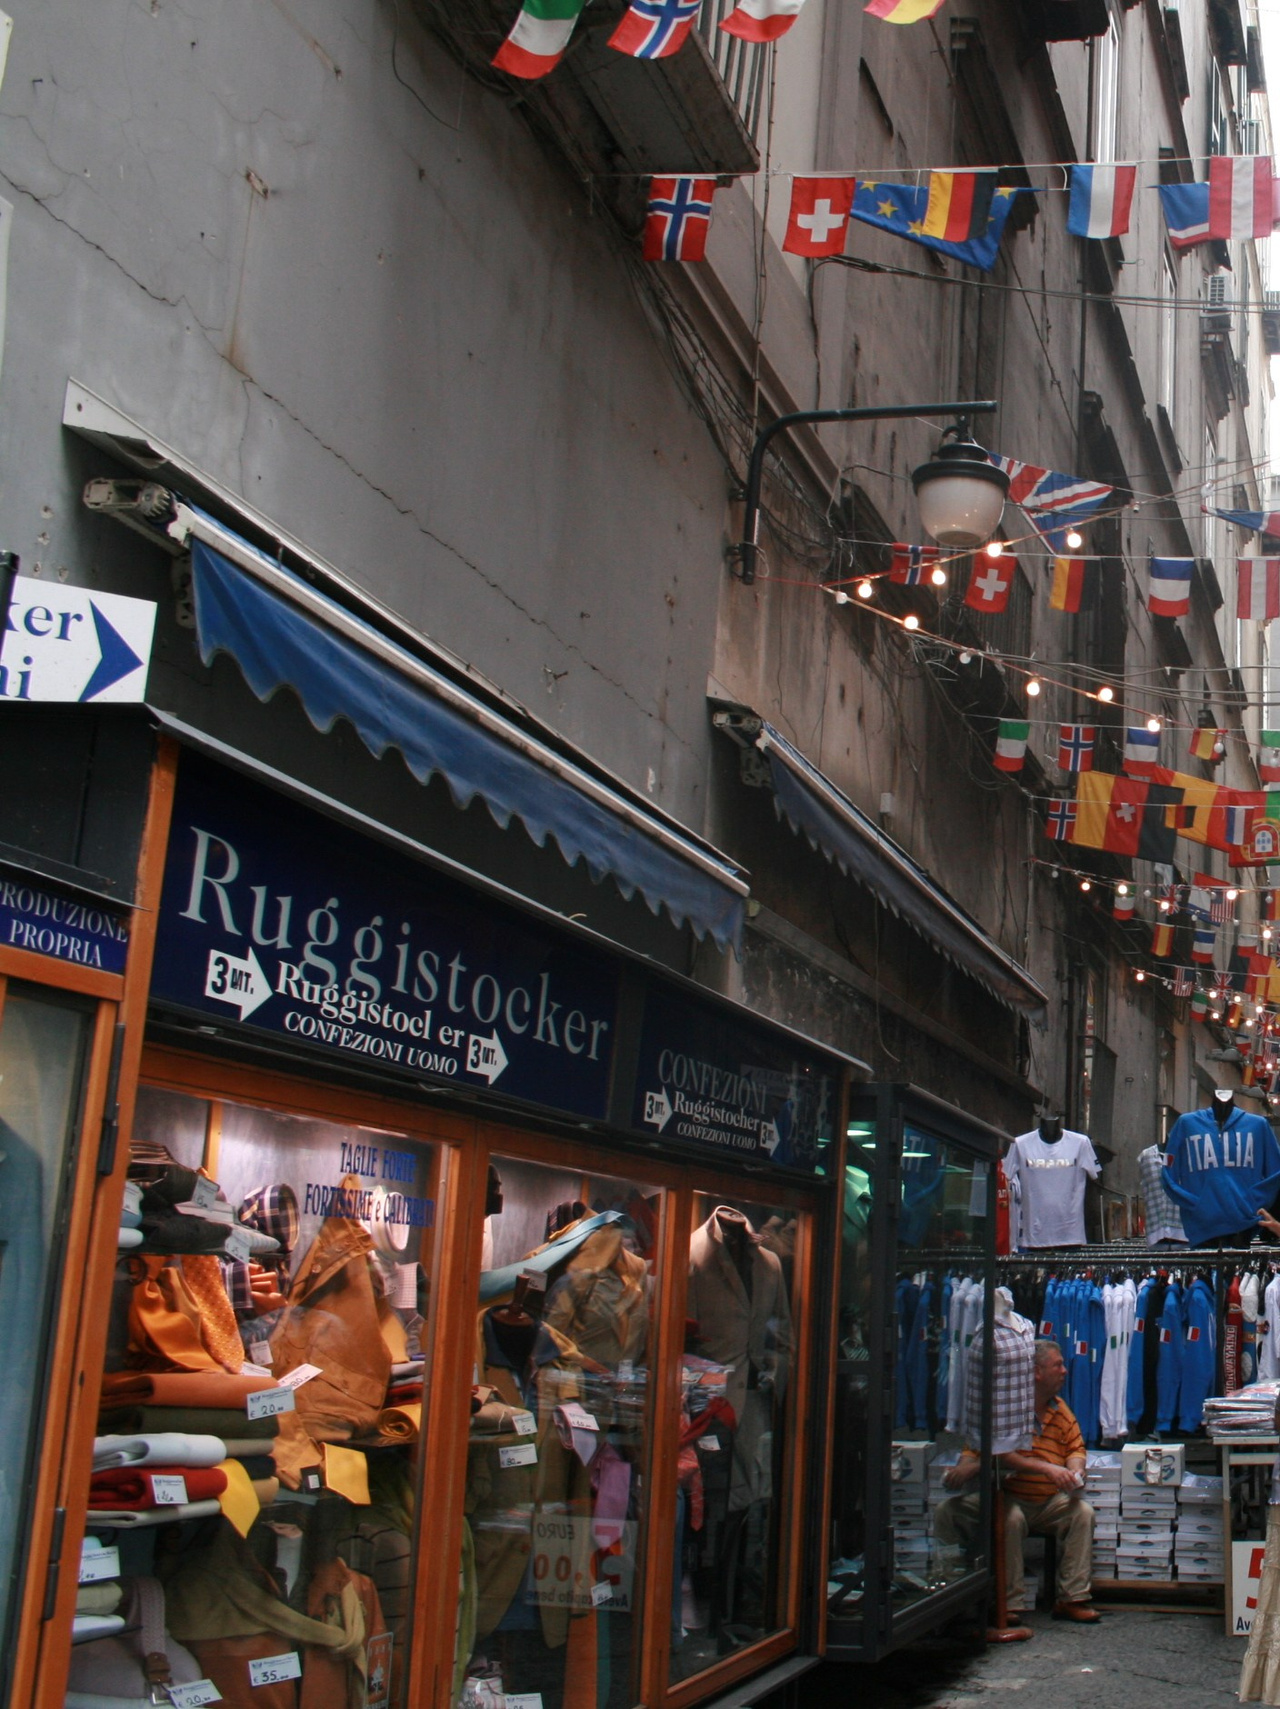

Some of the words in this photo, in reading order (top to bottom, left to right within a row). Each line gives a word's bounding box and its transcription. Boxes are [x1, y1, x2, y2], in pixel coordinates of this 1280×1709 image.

[9, 918, 102, 968] PROPRIA
[179, 826, 608, 1061] Ruggistocker
[212, 956, 229, 995] 3
[284, 1011, 403, 1062] CONFEZIONI
[407, 1047, 458, 1076] UOMO
[471, 1038, 482, 1069] 3
[658, 1049, 766, 1115] CONFEZIONI
[646, 1095, 655, 1120] 3
[677, 1121, 731, 1146] CONFEZIONI
[732, 1133, 757, 1151] UOMO
[1185, 1132, 1254, 1173] ITALIA
[340, 1142, 378, 1177] TAGLIE
[375, 1200, 382, 1222] e
